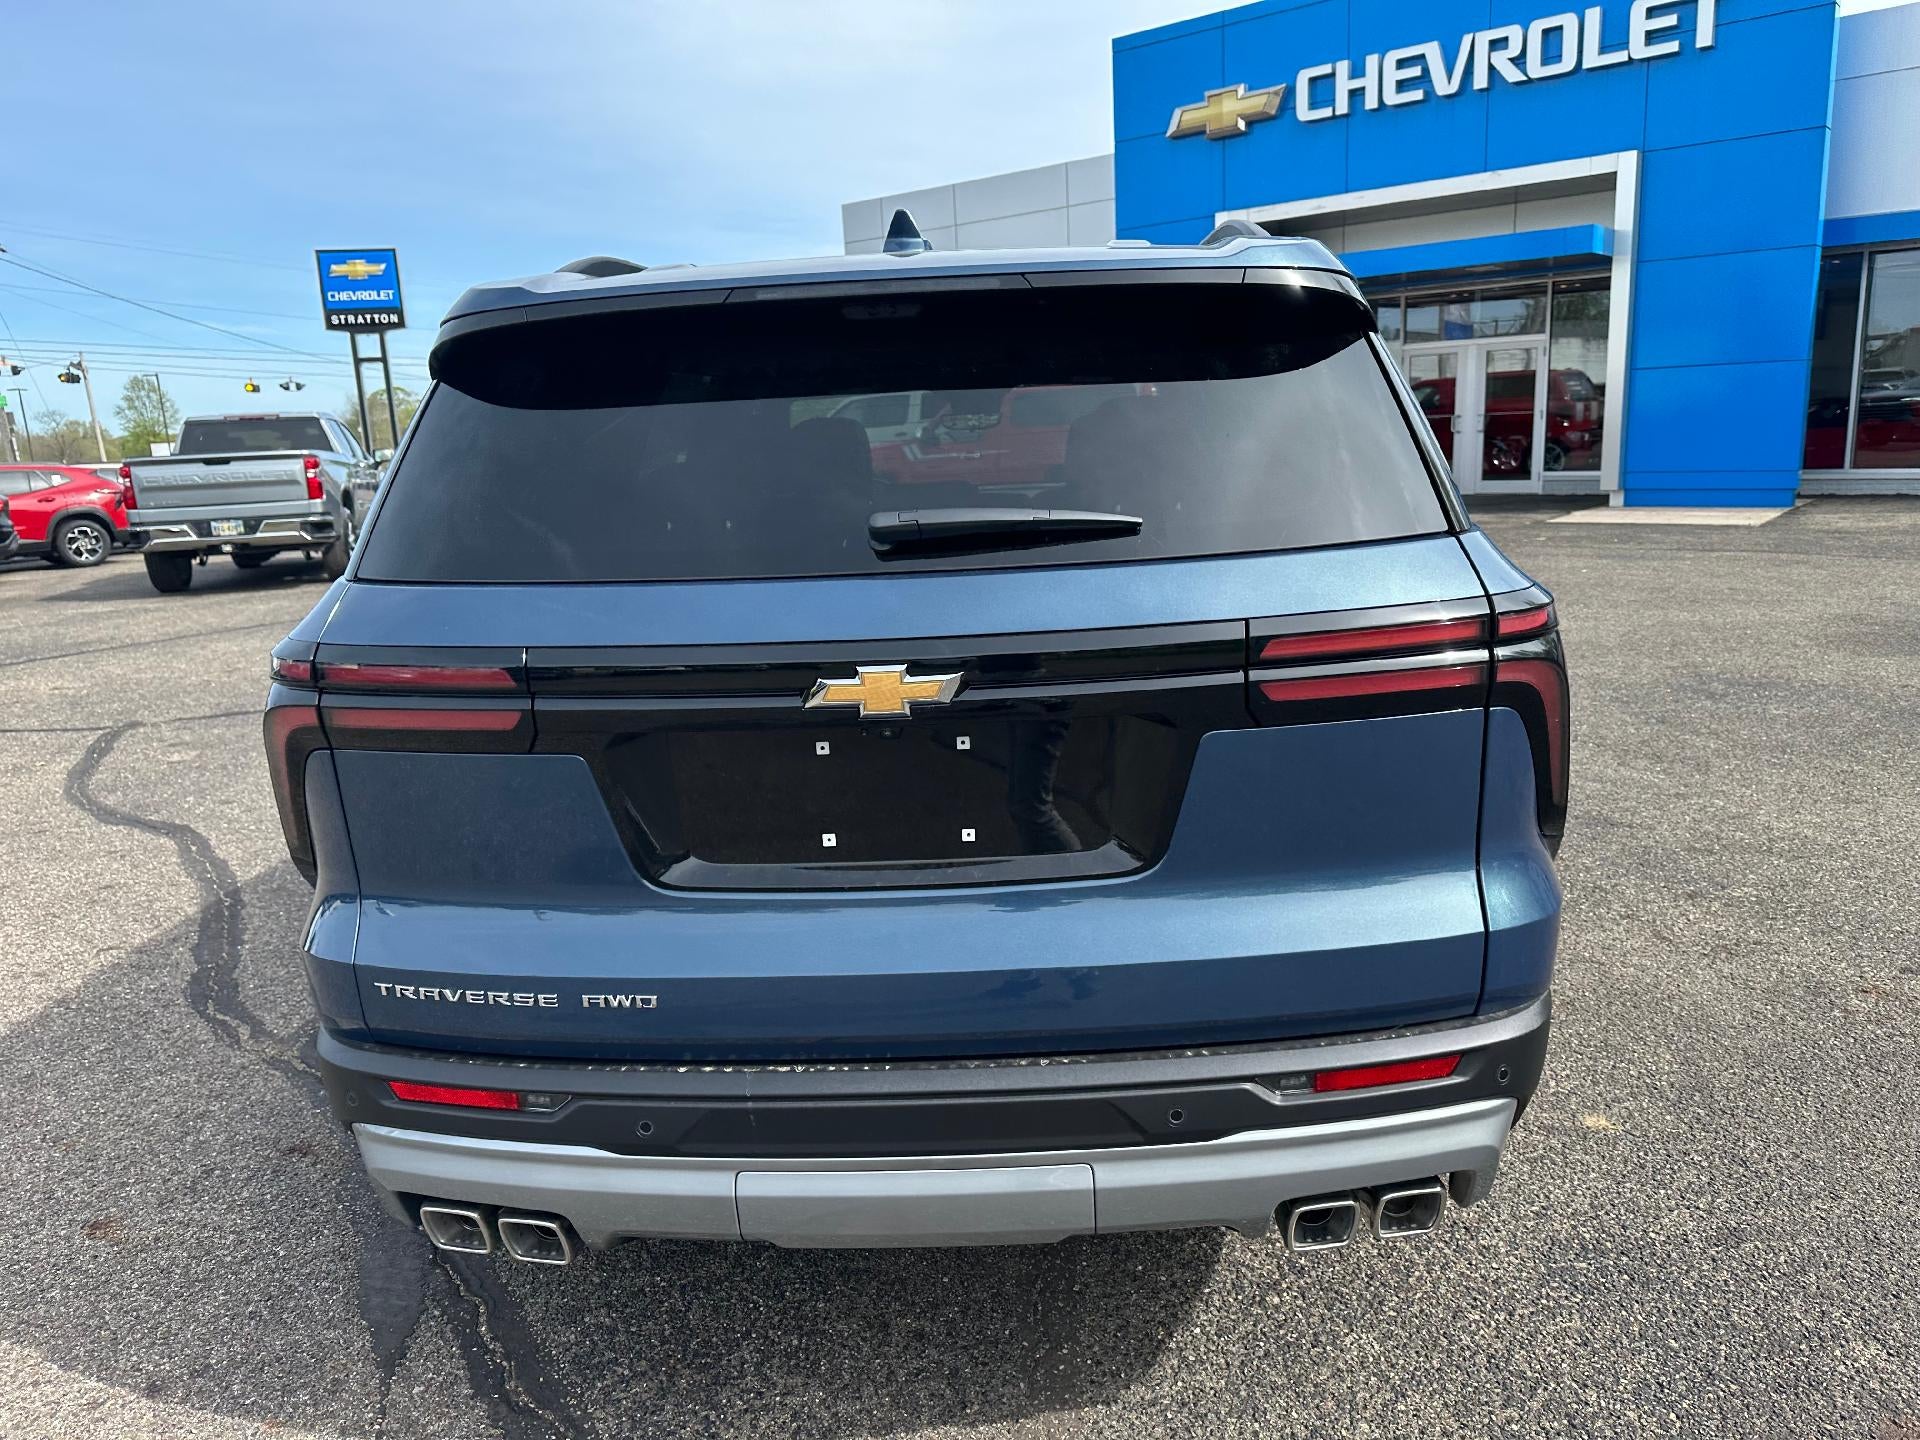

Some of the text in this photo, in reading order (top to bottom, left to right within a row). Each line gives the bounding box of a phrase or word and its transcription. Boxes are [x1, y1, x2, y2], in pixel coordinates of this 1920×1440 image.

[327, 289, 395, 302] CHEVROLET
[330, 313, 399, 325] STRATTON
[142, 470, 293, 487] CHEVROLET
[373, 982, 658, 1009] TRAVERSE AWD
